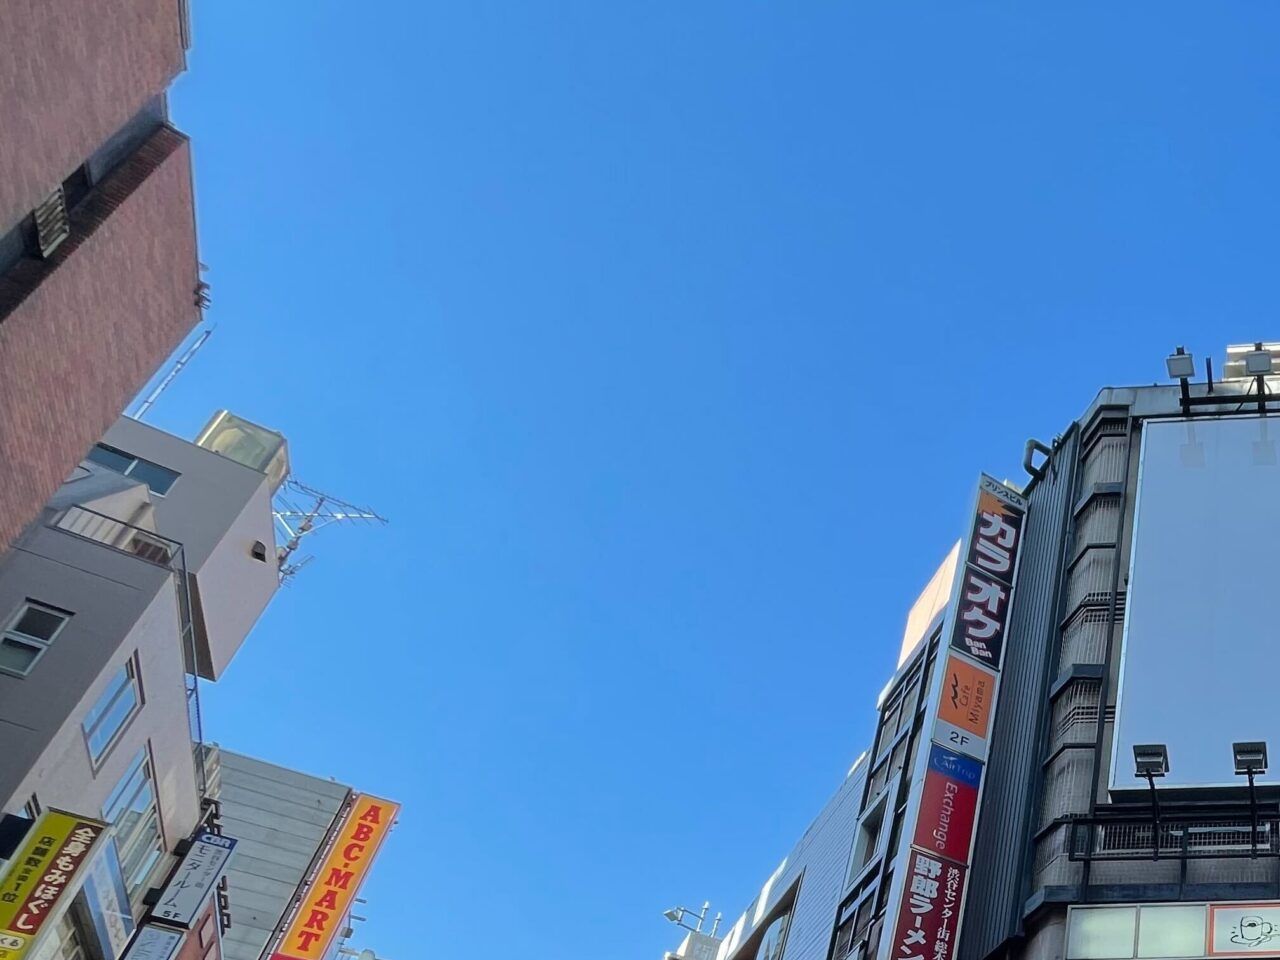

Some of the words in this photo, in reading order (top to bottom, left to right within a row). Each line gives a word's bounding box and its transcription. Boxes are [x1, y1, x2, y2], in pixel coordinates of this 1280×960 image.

[985, 480, 1023, 506] プリンスビル
[963, 512, 1016, 639] カラオケ
[959, 684, 970, 707] Cafe
[969, 679, 986, 725] Miyama
[949, 730, 970, 746] 2F
[932, 782, 958, 850] Exchange
[17, 827, 96, 930] 全身もみほぐし
[164, 846, 209, 908] モニタールーム
[297, 804, 382, 952] ABC-MART
[162, 910, 181, 919] 5F
